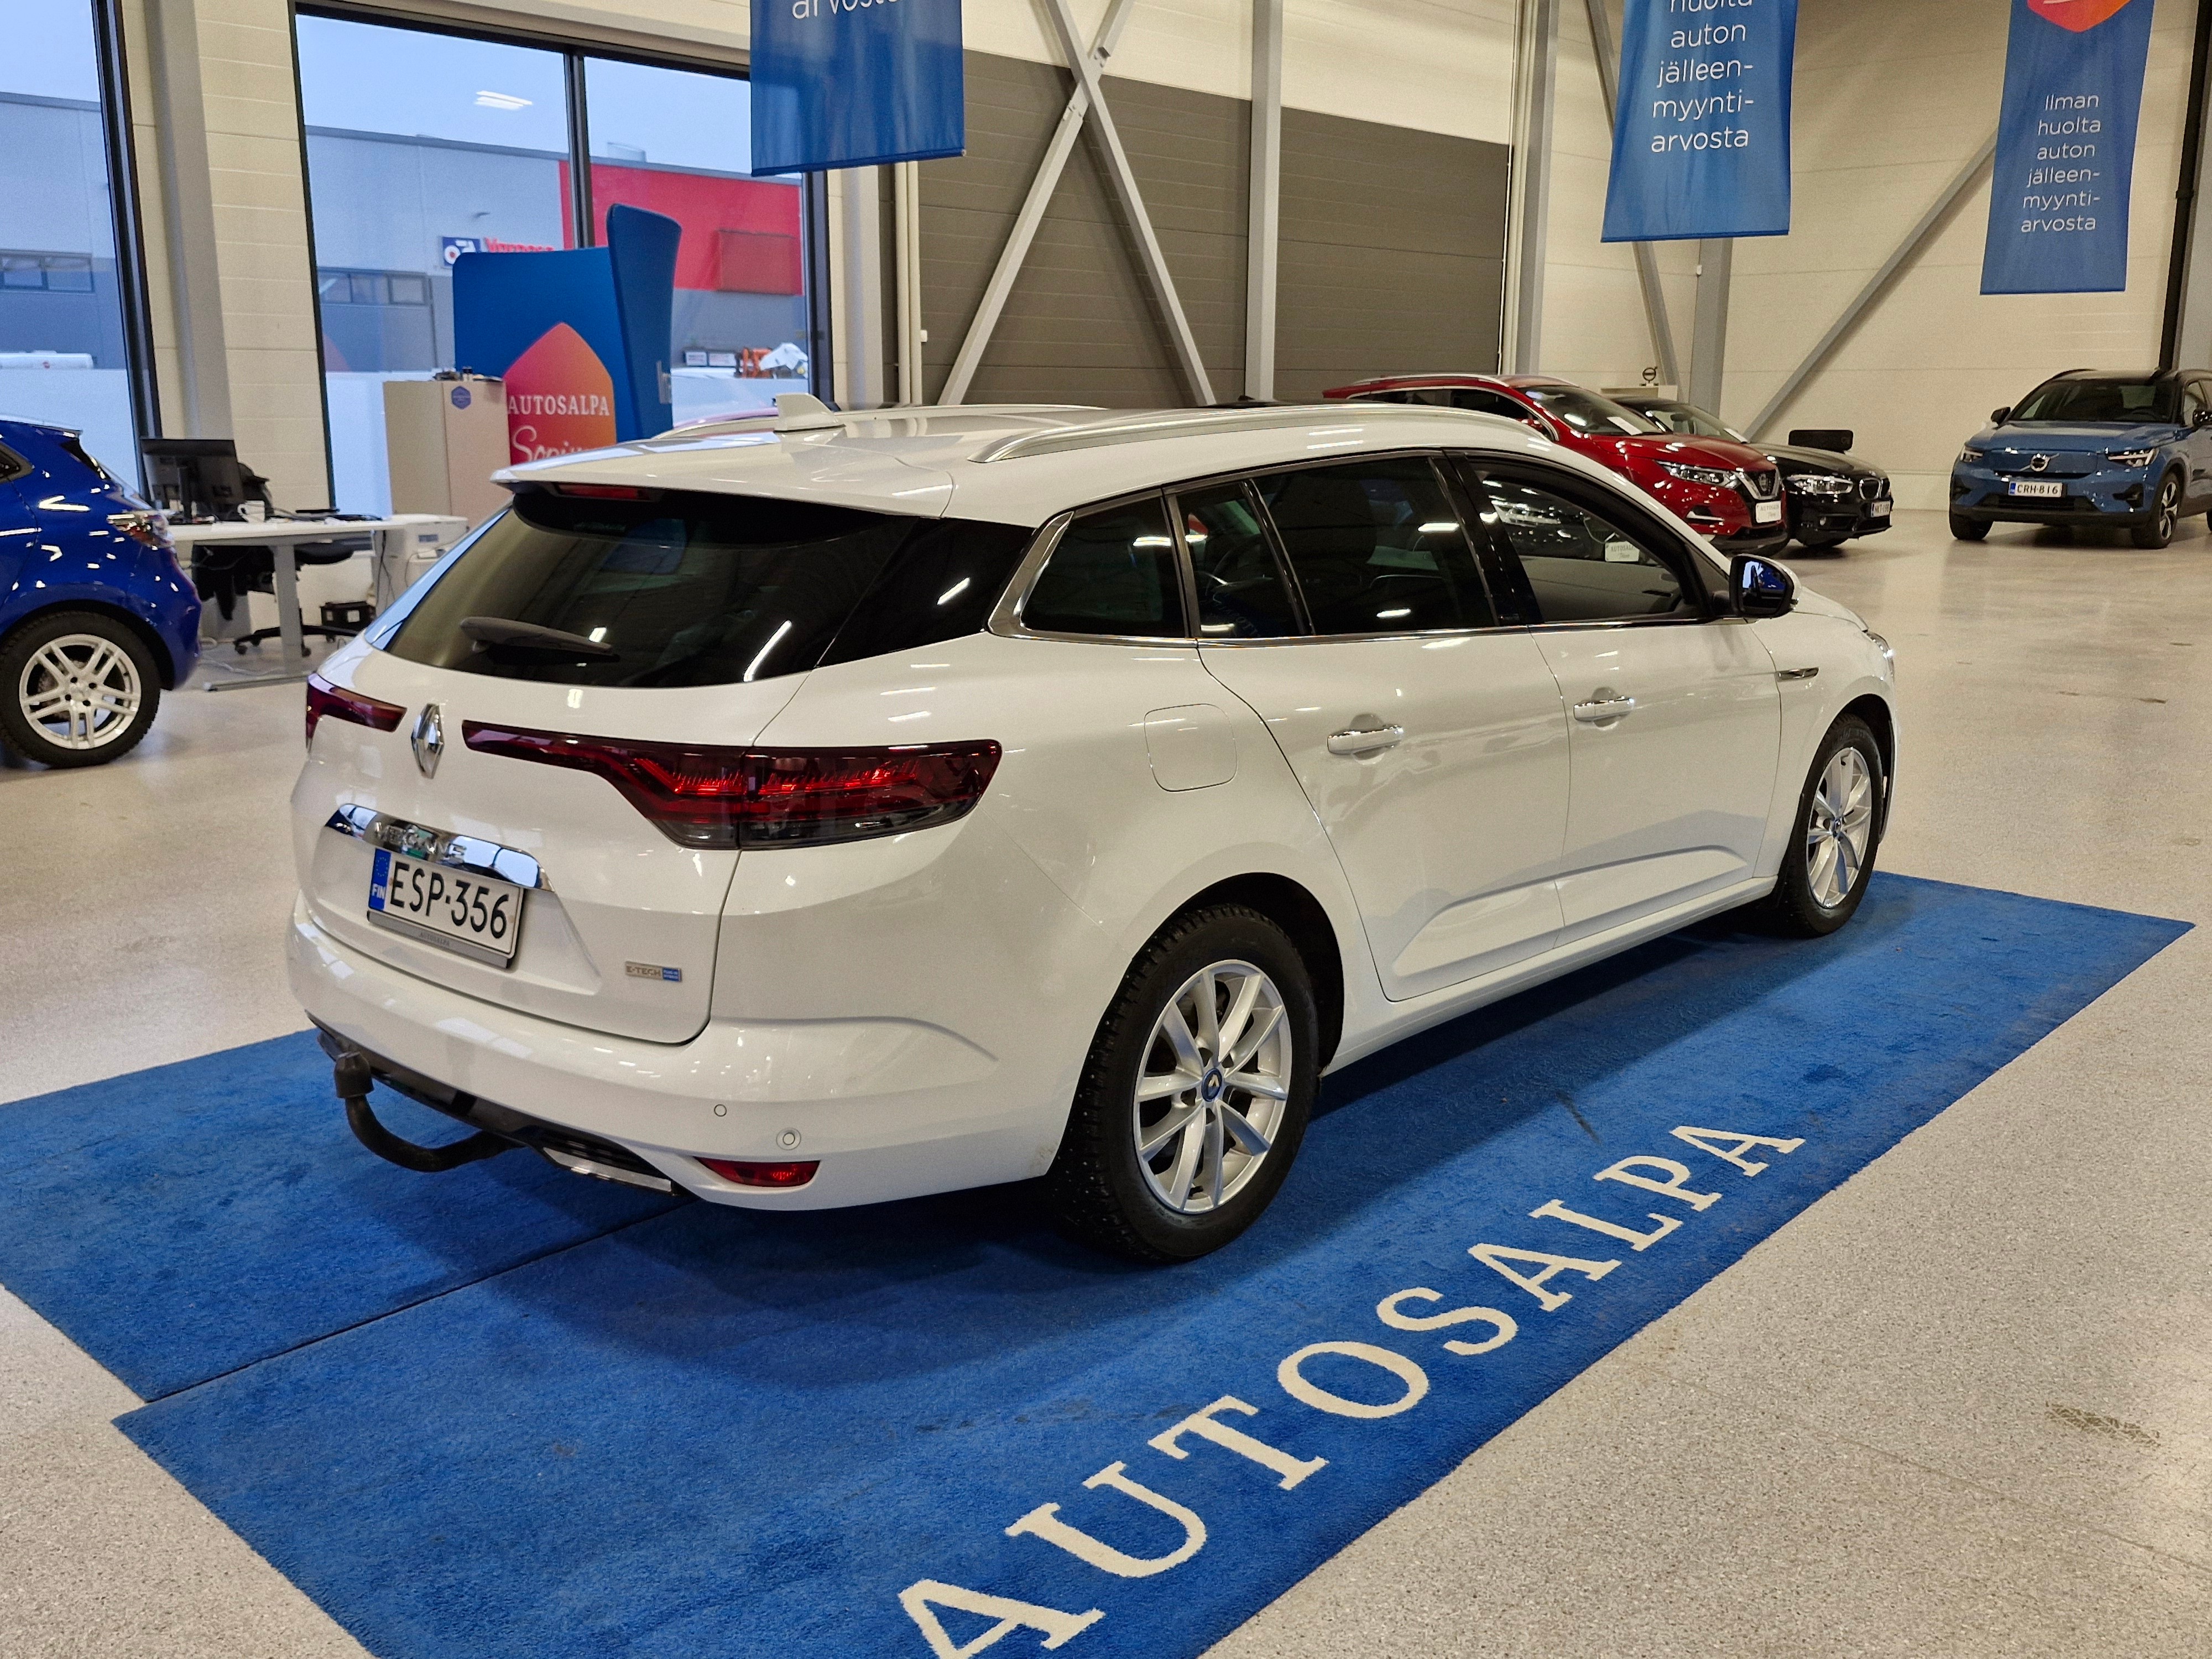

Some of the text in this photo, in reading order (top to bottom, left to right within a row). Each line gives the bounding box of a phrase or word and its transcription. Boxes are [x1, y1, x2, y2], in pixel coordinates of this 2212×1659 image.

[1670, 24, 1746, 48] auton
[1656, 58, 1754, 88] jälleen-
[1652, 88, 1755, 122] myynti-
[2044, 93, 2100, 111] Ilman
[2037, 116, 2101, 136] huolta
[1651, 126, 1749, 153] arvosta
[2037, 142, 2096, 160] auton
[2026, 166, 2101, 188] jälleen-
[2022, 189, 2101, 211] myynti-
[2020, 215, 2096, 233] arvosta
[508, 394, 610, 416] AUTOSALPA
[2017, 484, 2058, 495] CRH-816
[371, 883, 386, 899] FIN
[390, 860, 510, 939] ESP-356
[898, 1125, 1806, 1659] AUTOSALPA
